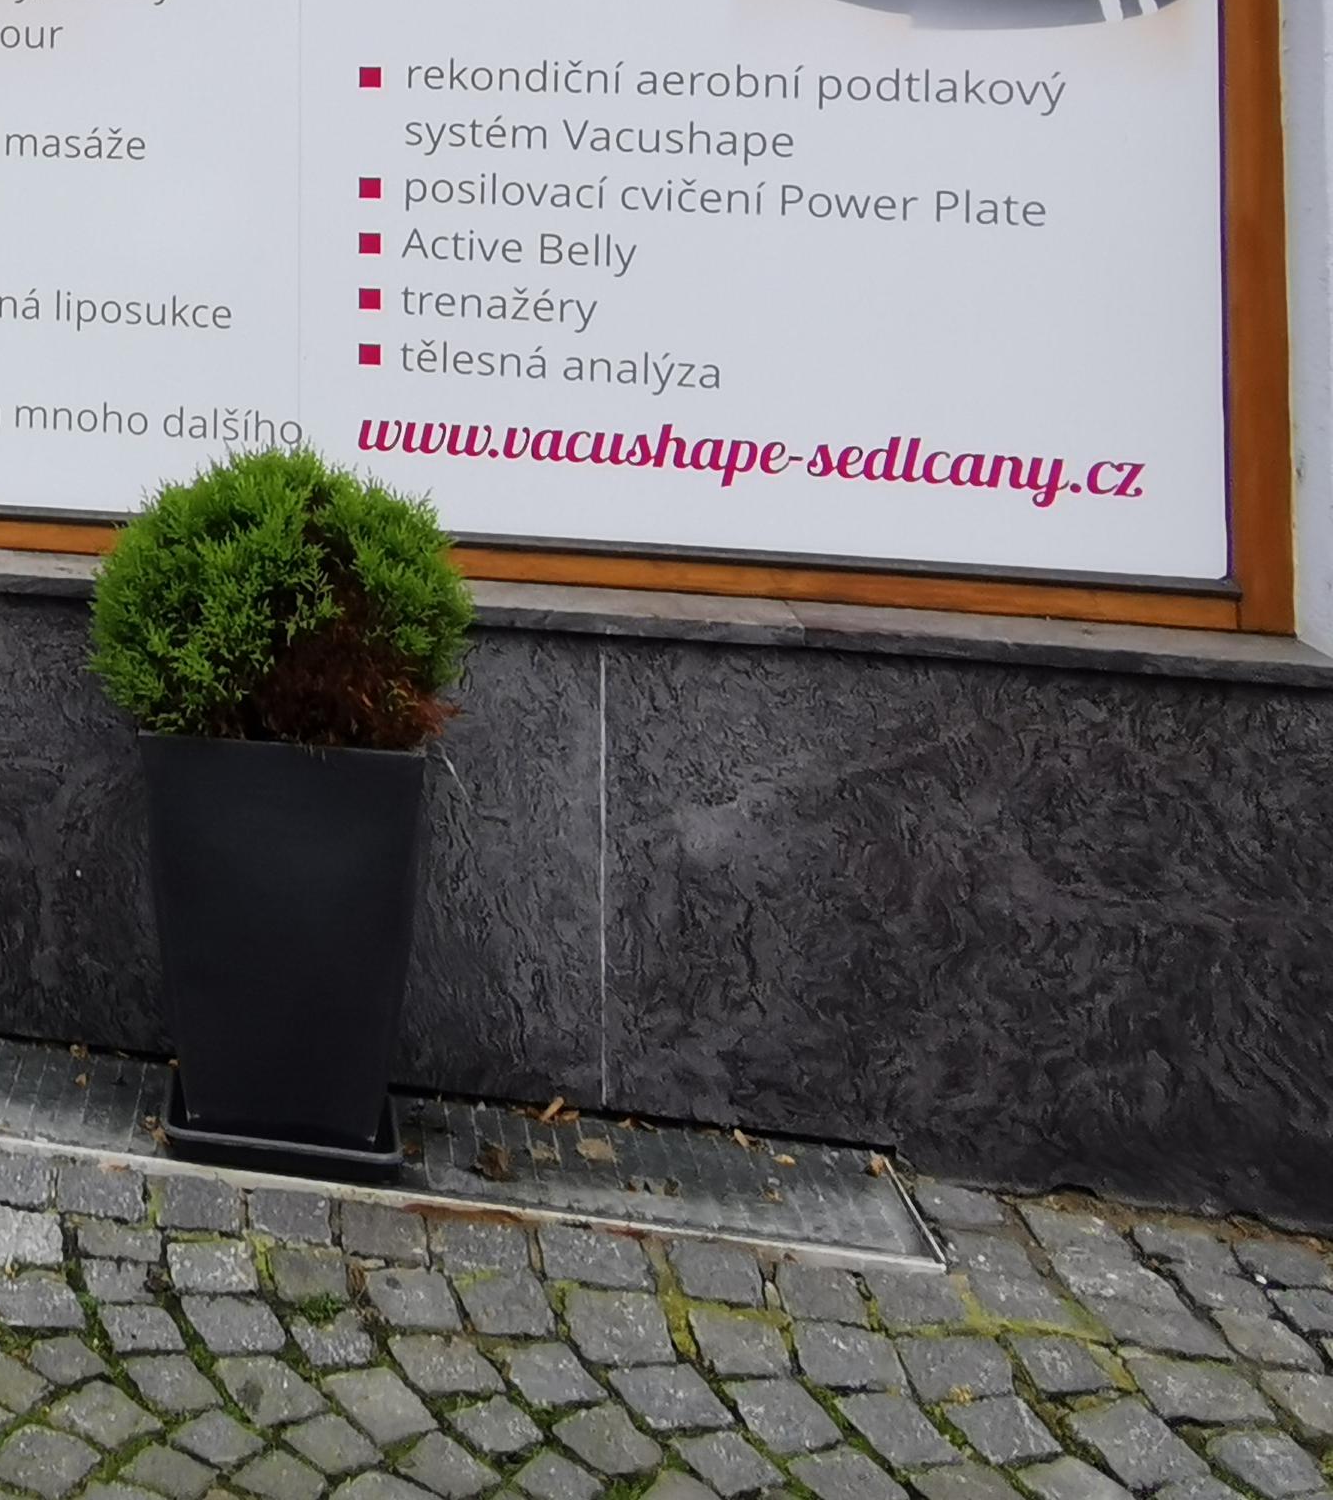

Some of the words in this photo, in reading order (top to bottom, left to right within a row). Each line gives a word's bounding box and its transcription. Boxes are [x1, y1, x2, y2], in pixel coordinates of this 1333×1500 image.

[407, 58, 621, 97] rekondiční
[636, 65, 800, 100] aerobní
[818, 70, 1067, 116] podtlakový
[5, 127, 147, 162] masáže
[404, 116, 547, 159] systém
[563, 119, 795, 166] Vacushape
[404, 173, 606, 211] posilovací
[620, 178, 762, 216] cvičení
[781, 185, 918, 222] Power
[935, 190, 1046, 227] Plate
[401, 227, 523, 264] Active
[539, 234, 636, 276] Belly
[55, 290, 233, 331] liposukce
[401, 283, 598, 332] trenažéry
[401, 339, 546, 380] tělesná
[563, 350, 721, 394] analýza
[14, 403, 149, 438] mnoho
[163, 408, 302, 451] dalšího
[357, 417, 1146, 508] www.vacushape-sedlcany.cz
